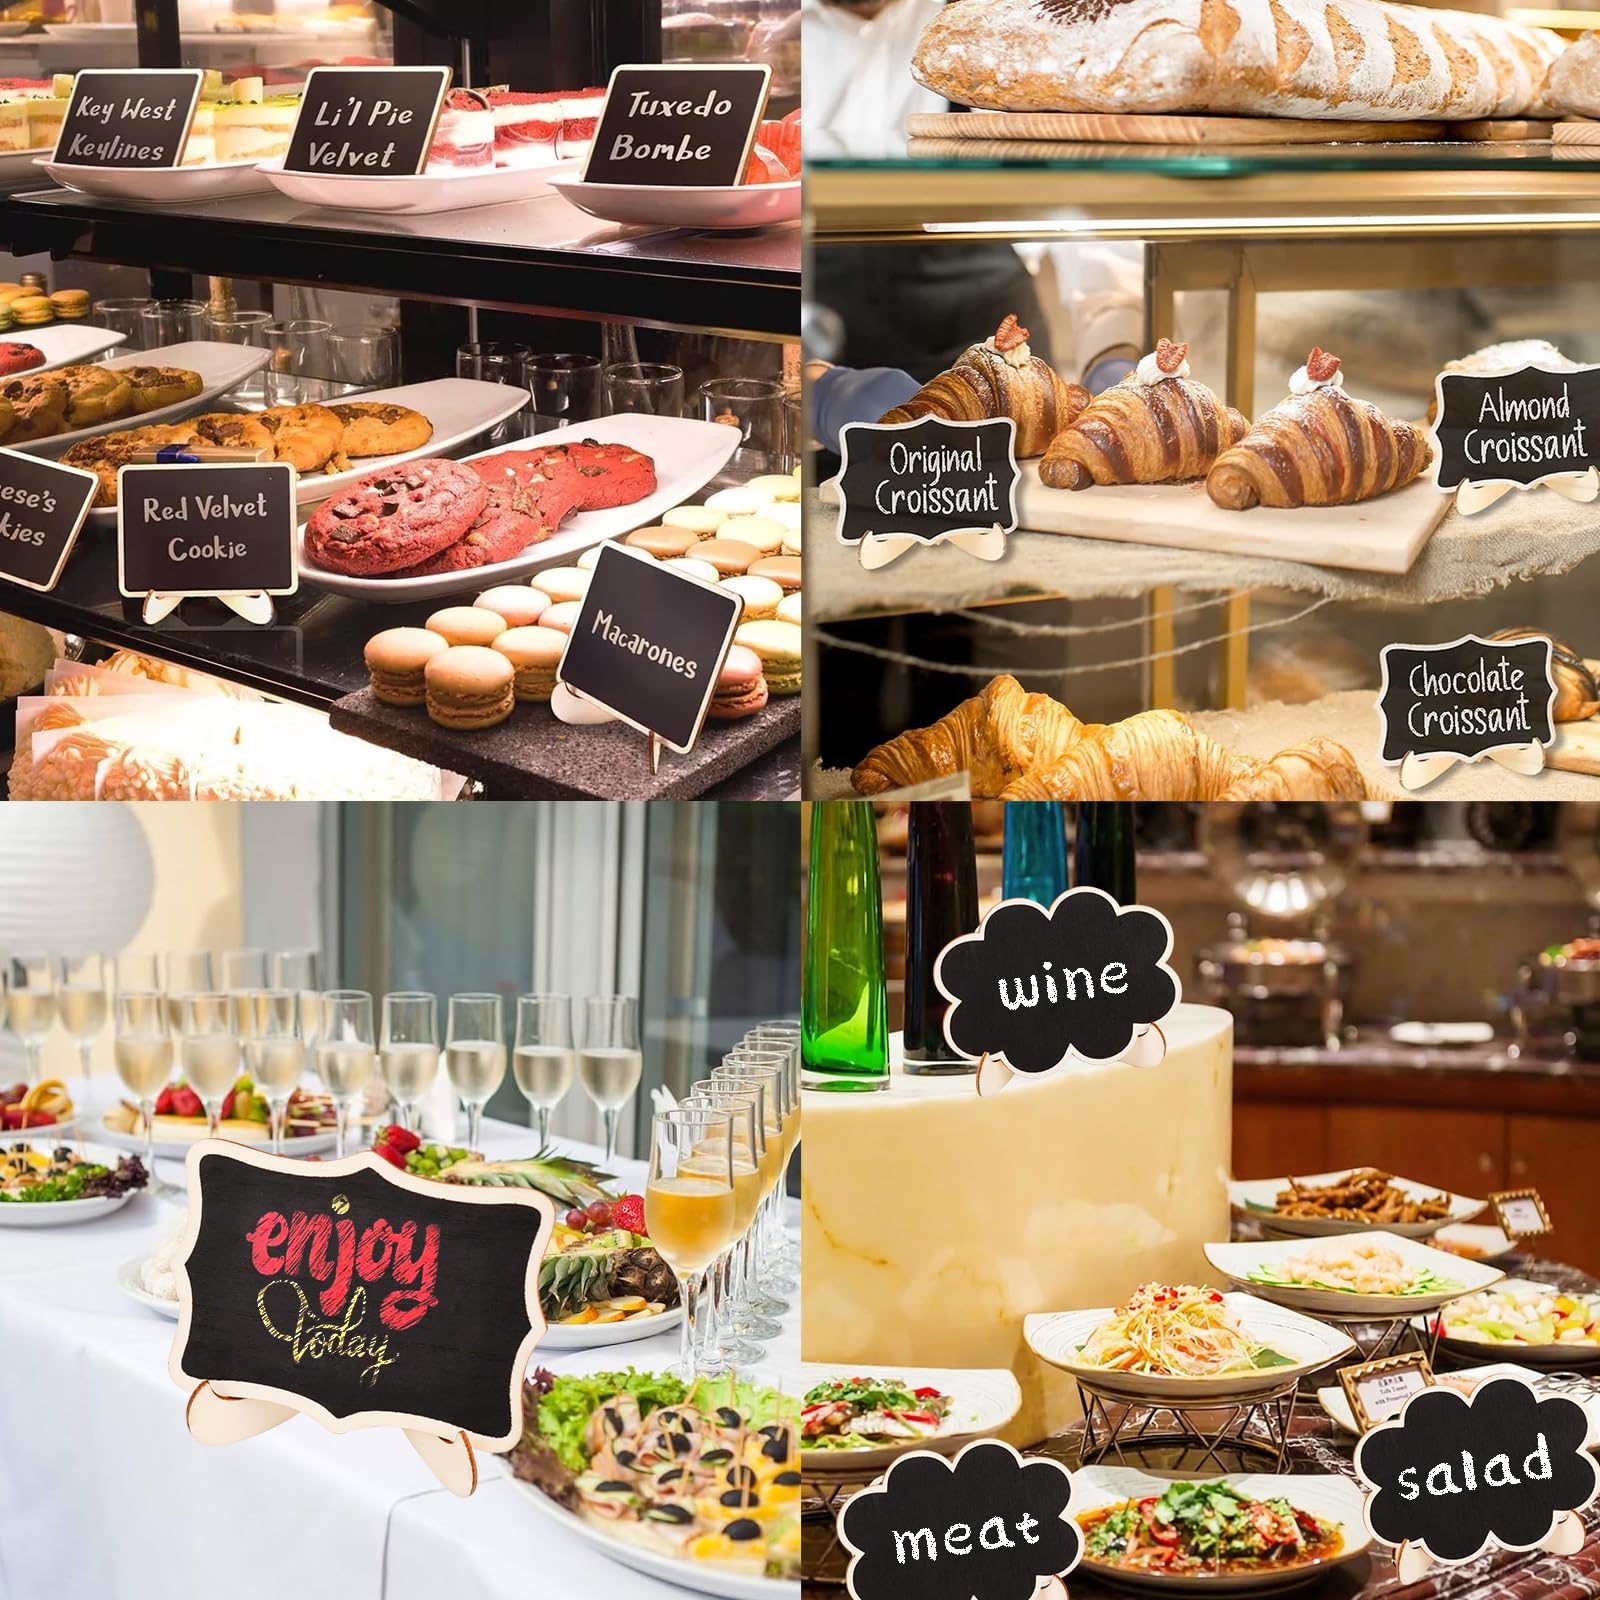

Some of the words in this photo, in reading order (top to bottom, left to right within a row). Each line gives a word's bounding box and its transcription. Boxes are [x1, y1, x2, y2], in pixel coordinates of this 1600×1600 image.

[76, 95, 115, 125] Key
[120, 97, 177, 121] West
[367, 100, 414, 127] Pie
[628, 89, 732, 118] Tuxedo
[68, 133, 164, 161] Keylines
[309, 141, 396, 168] Velvet
[609, 134, 712, 162] Bombe
[1478, 382, 1570, 423] Almond
[889, 435, 982, 487] Original
[1464, 418, 1589, 464] Croissant
[0, 484, 57, 513] ese's
[143, 496, 188, 523] Red
[194, 492, 268, 520] Velvet
[875, 472, 1000, 515] Croissant
[168, 535, 247, 562] Cookie
[591, 609, 698, 679] Macarones
[1409, 655, 1525, 697] Chocolate
[1408, 691, 1532, 738] Croissant
[997, 961, 1129, 1011] wine
[245, 1193, 441, 1331] enjoy
[1397, 1432, 1553, 1501] salad
[891, 1512, 1040, 1565] meat
